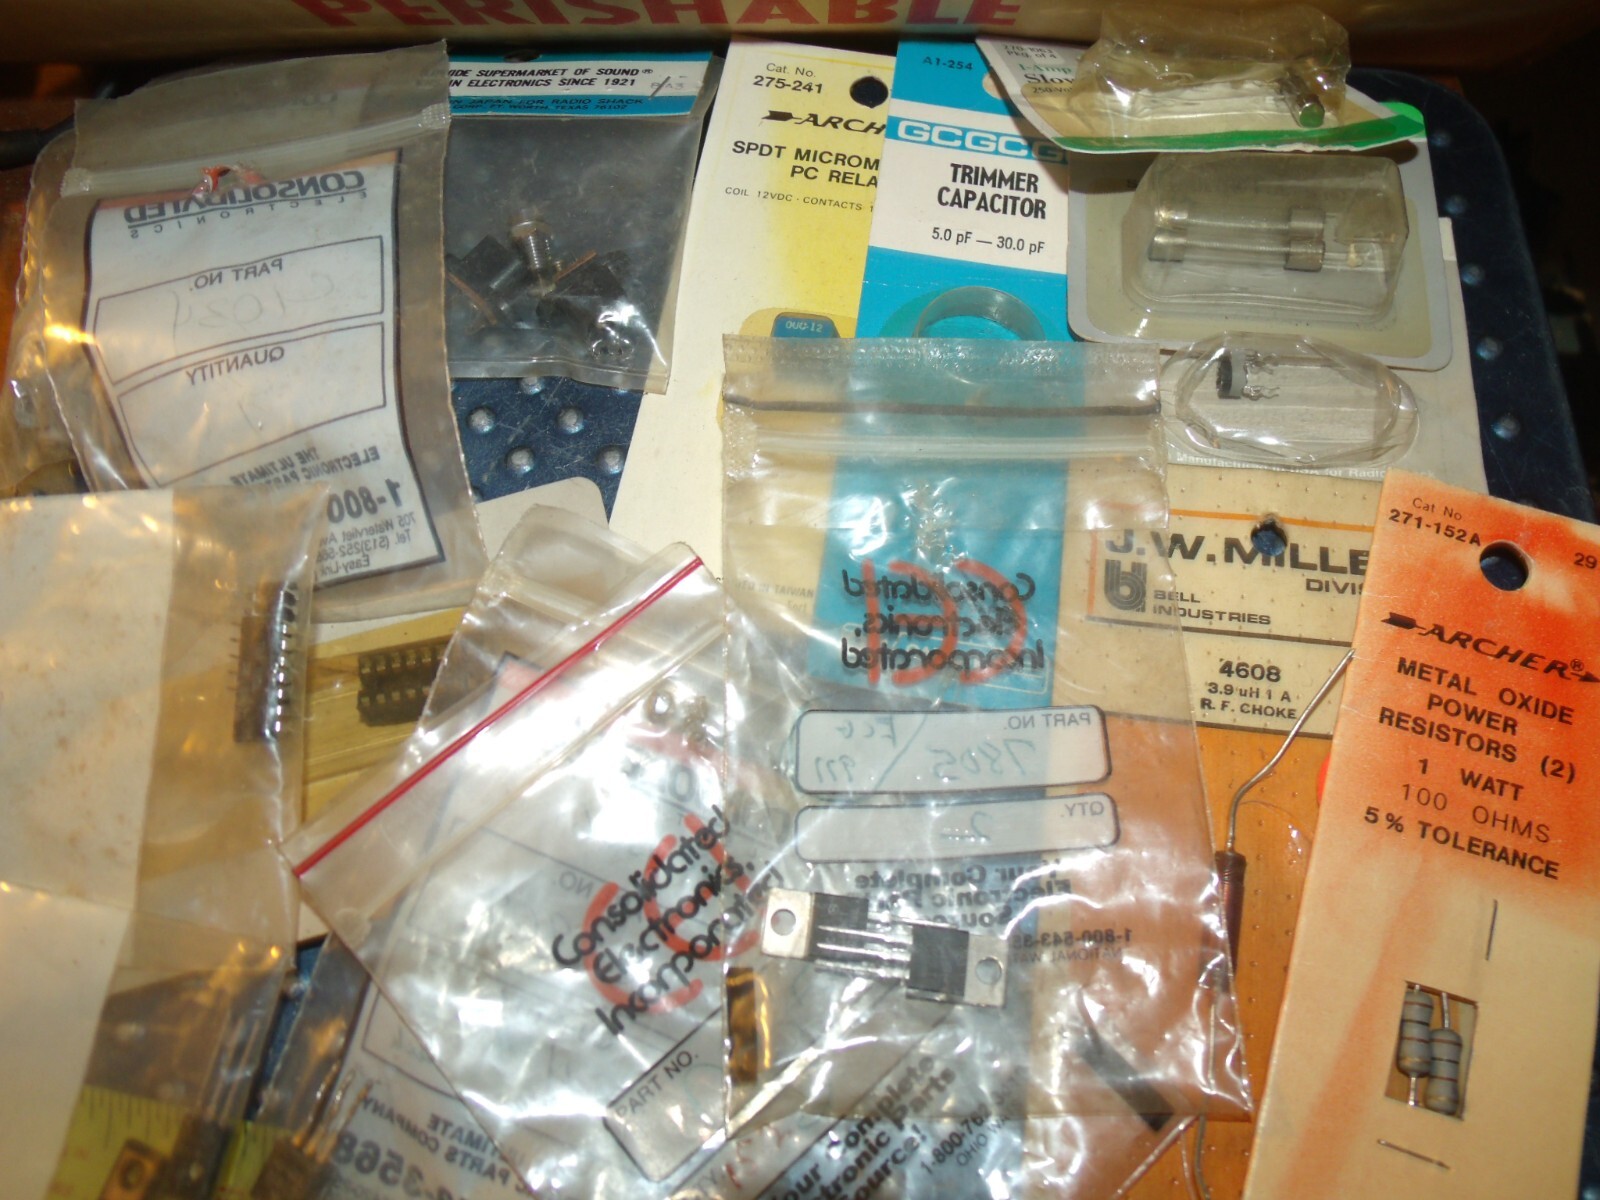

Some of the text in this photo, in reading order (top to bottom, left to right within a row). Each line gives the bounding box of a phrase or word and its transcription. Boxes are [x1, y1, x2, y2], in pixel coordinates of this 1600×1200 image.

[293, 0, 1020, 27] PERISHABLE
[476, 68, 568, 77] SUPERMARKET
[573, 68, 592, 76] OF
[766, 62, 817, 78] Cat. No.
[923, 56, 974, 71] A1-254
[466, 78, 551, 88] ELECTRONICS
[557, 77, 598, 87] SINCE
[603, 78, 637, 87] 1921
[753, 75, 823, 95] 275-241
[732, 140, 787, 159] SPDT
[790, 165, 819, 181] PC
[950, 162, 1040, 194] TRIMMER
[725, 187, 750, 198] COIL
[757, 190, 793, 203] 12VDC
[803, 196, 864, 212] CONTACTS
[937, 186, 1048, 220] CAPACITOR
[931, 226, 1046, 256] 5.0 pF 30.0 pF
[1412, 497, 1463, 522] Cat No
[1388, 508, 1482, 548] 271-152A
[1573, 552, 1598, 570] 29
[1153, 589, 1202, 604] BELL
[1153, 603, 1272, 626] INDUSTRIES
[1218, 658, 1282, 683] 4608
[1207, 682, 1234, 695] 3.9
[1280, 690, 1292, 703] A
[1397, 656, 1575, 726] METAL OXIDE
[1240, 703, 1297, 720] CHOKE
[1426, 693, 1519, 737] POWER
[1378, 706, 1577, 785] RESISTORS (2)
[1418, 758, 1525, 802] 1 WATT
[1401, 783, 1551, 844] 100 OHMS
[1418, 820, 1561, 881] TOLERANCE
[663, 1049, 699, 1081] NO.
